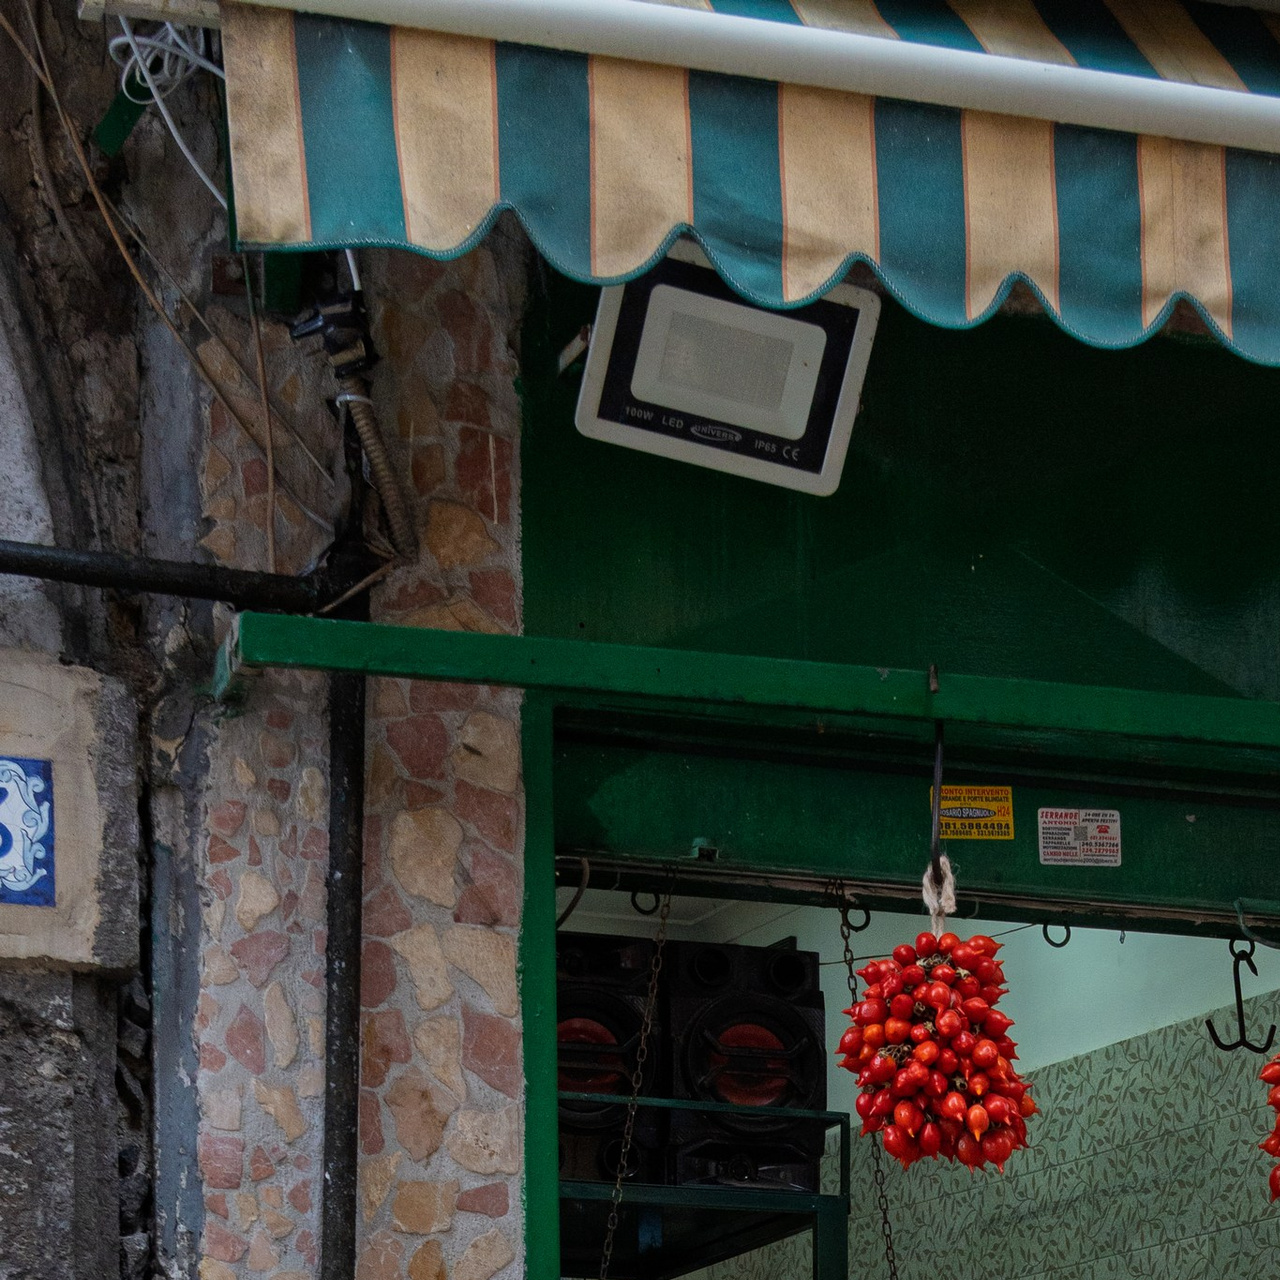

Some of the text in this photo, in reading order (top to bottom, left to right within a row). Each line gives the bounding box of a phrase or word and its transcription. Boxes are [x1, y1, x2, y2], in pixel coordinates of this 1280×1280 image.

[625, 406, 654, 421] 100W
[662, 415, 684, 429] LED
[755, 439, 776, 454] IP65
[965, 788, 1010, 796] INTERVENTO
[997, 806, 1010, 817] H24
[1040, 811, 1079, 820] SERRANDE
